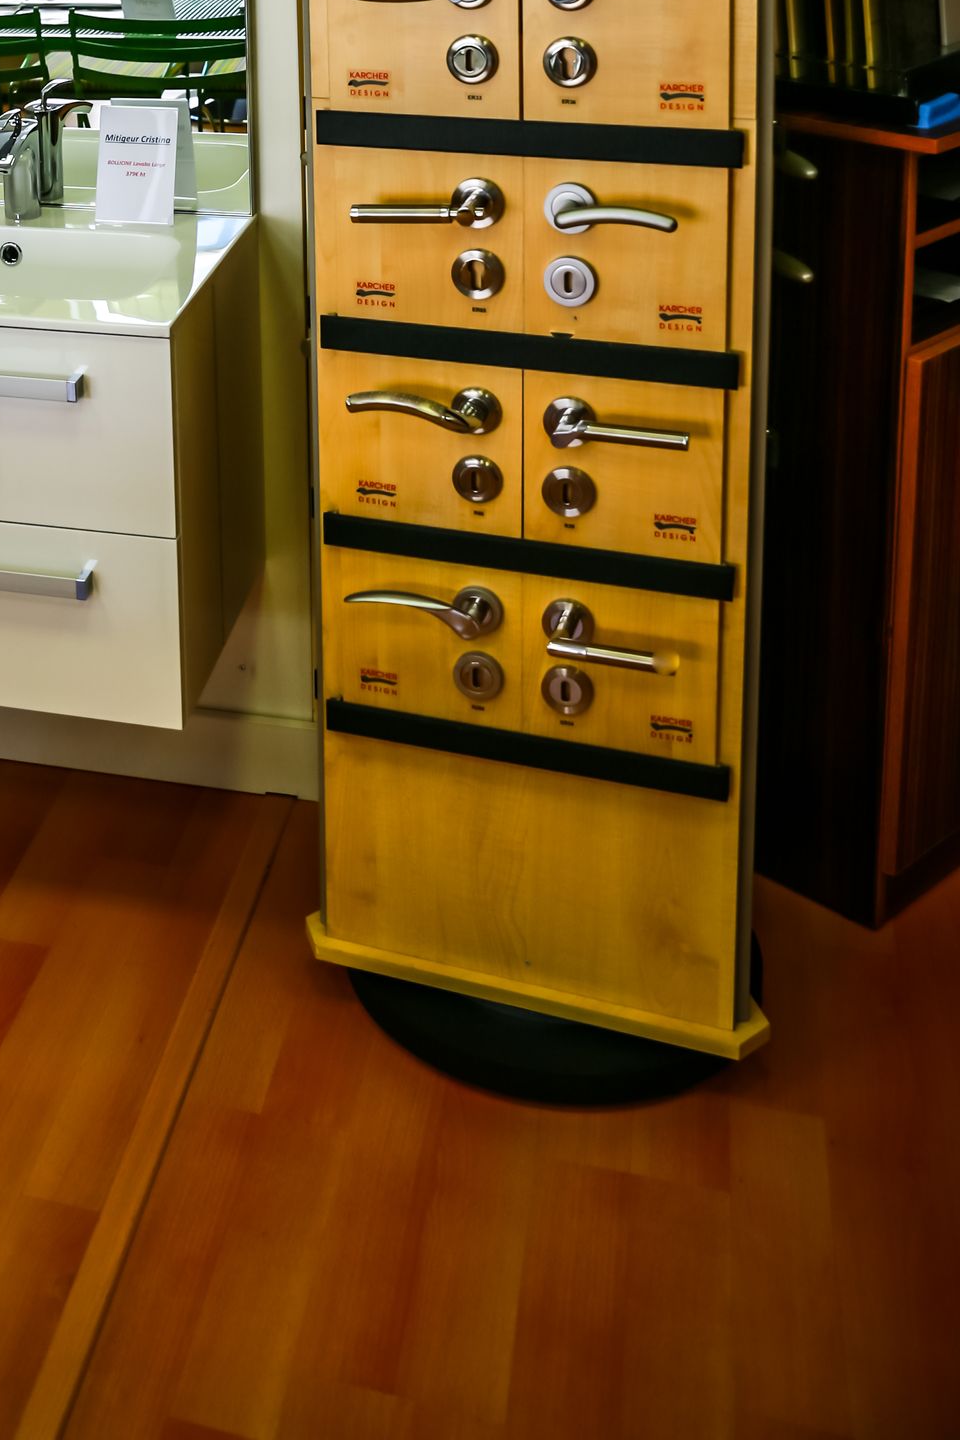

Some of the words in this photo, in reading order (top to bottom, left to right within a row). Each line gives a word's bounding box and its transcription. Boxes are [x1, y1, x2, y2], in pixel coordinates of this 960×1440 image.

[349, 71, 389, 80] KARCHER
[350, 89, 389, 97] DESIGN
[659, 83, 704, 93] KARCHER
[660, 102, 704, 111] DESIGN
[105, 134, 139, 143] Mitigeur
[141, 135, 171, 144] Cristina
[356, 281, 396, 291] KARCHER
[357, 298, 396, 308] DESIGN
[658, 304, 703, 315] KARCHER
[659, 322, 702, 332] DESIGN
[358, 480, 397, 492] KARCHER
[358, 496, 397, 508] DESIGN
[654, 513, 697, 525] KARCHER
[654, 531, 696, 542] DESIGN
[360, 668, 398, 681] KARCHER
[360, 683, 398, 696] DESIGN
[650, 731, 693, 743] DESIGN
